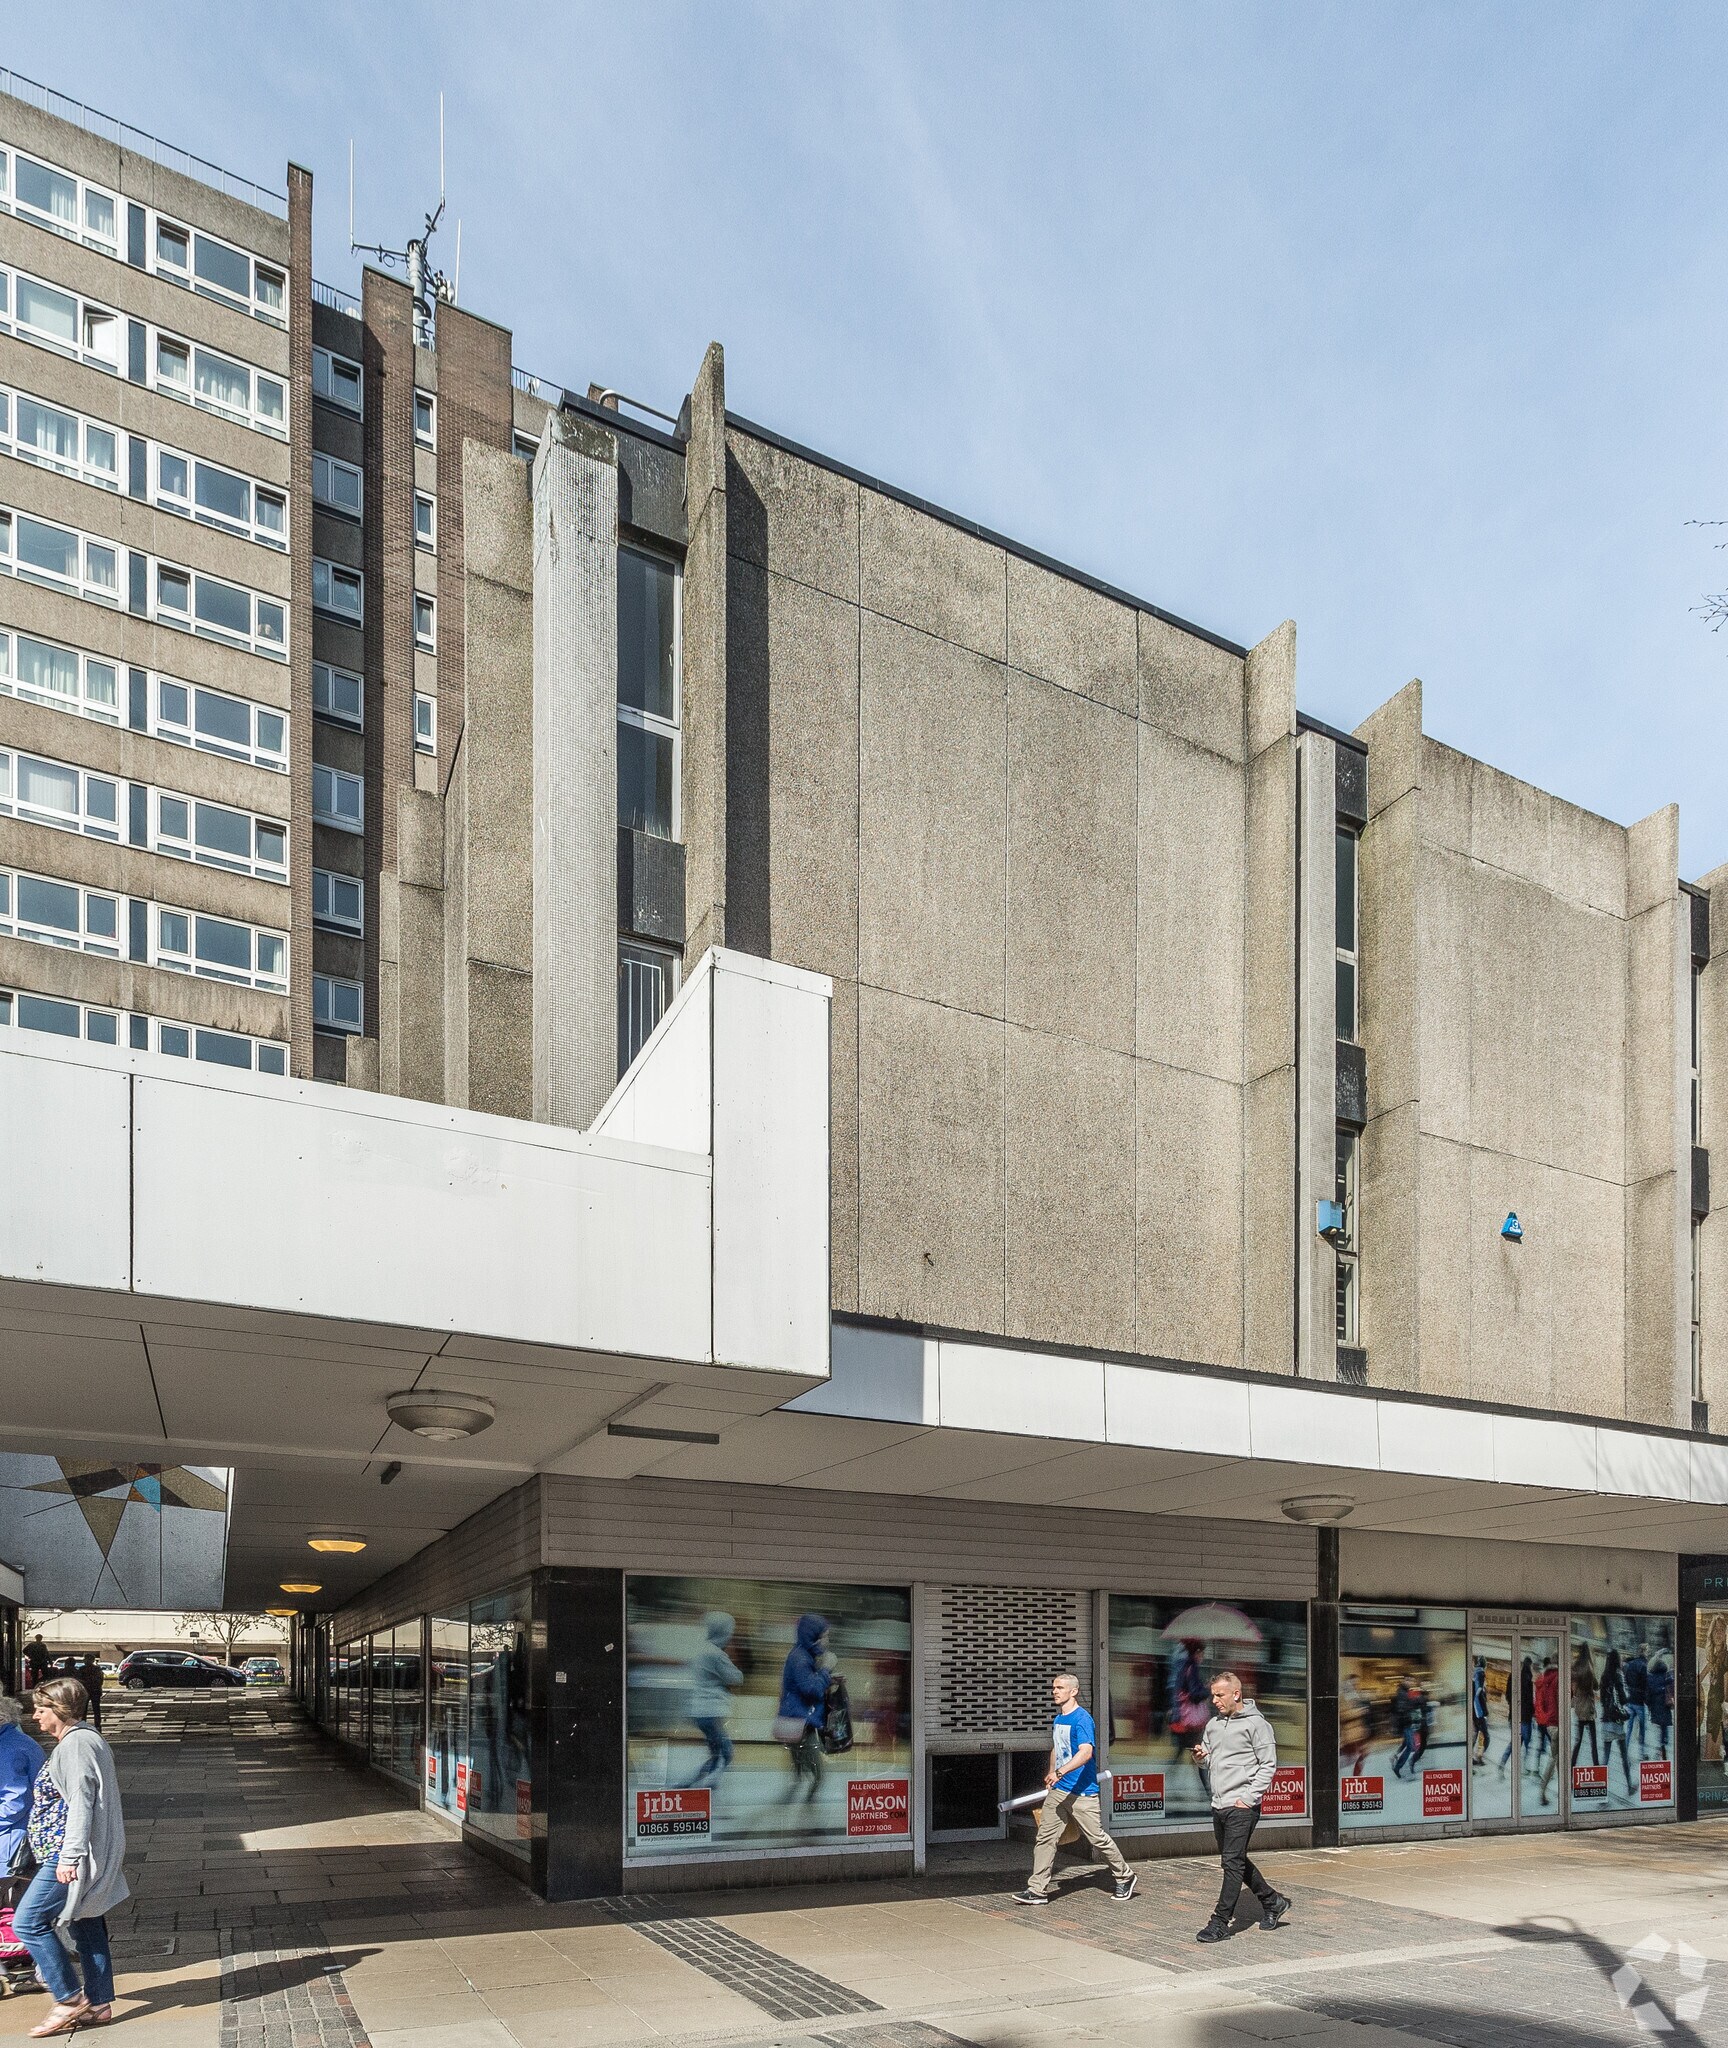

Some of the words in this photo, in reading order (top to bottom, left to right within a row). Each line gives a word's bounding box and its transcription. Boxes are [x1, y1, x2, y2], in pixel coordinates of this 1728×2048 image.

[1704, 1577, 1728, 1588] PR
[1576, 1768, 1595, 1786] jrbt
[1641, 1772, 1670, 1784] MASON
[1117, 1776, 1145, 1797] jrbt
[1345, 1779, 1368, 1797] jrbt
[1425, 1783, 1461, 1796] MASON
[643, 1792, 683, 1818] jrbt
[851, 1795, 907, 1811] MASON
[1114, 1802, 1135, 1811] 01865
[1138, 1801, 1163, 1810] 595143
[639, 1823, 669, 1834] 01865
[673, 1821, 708, 1832] 595143
